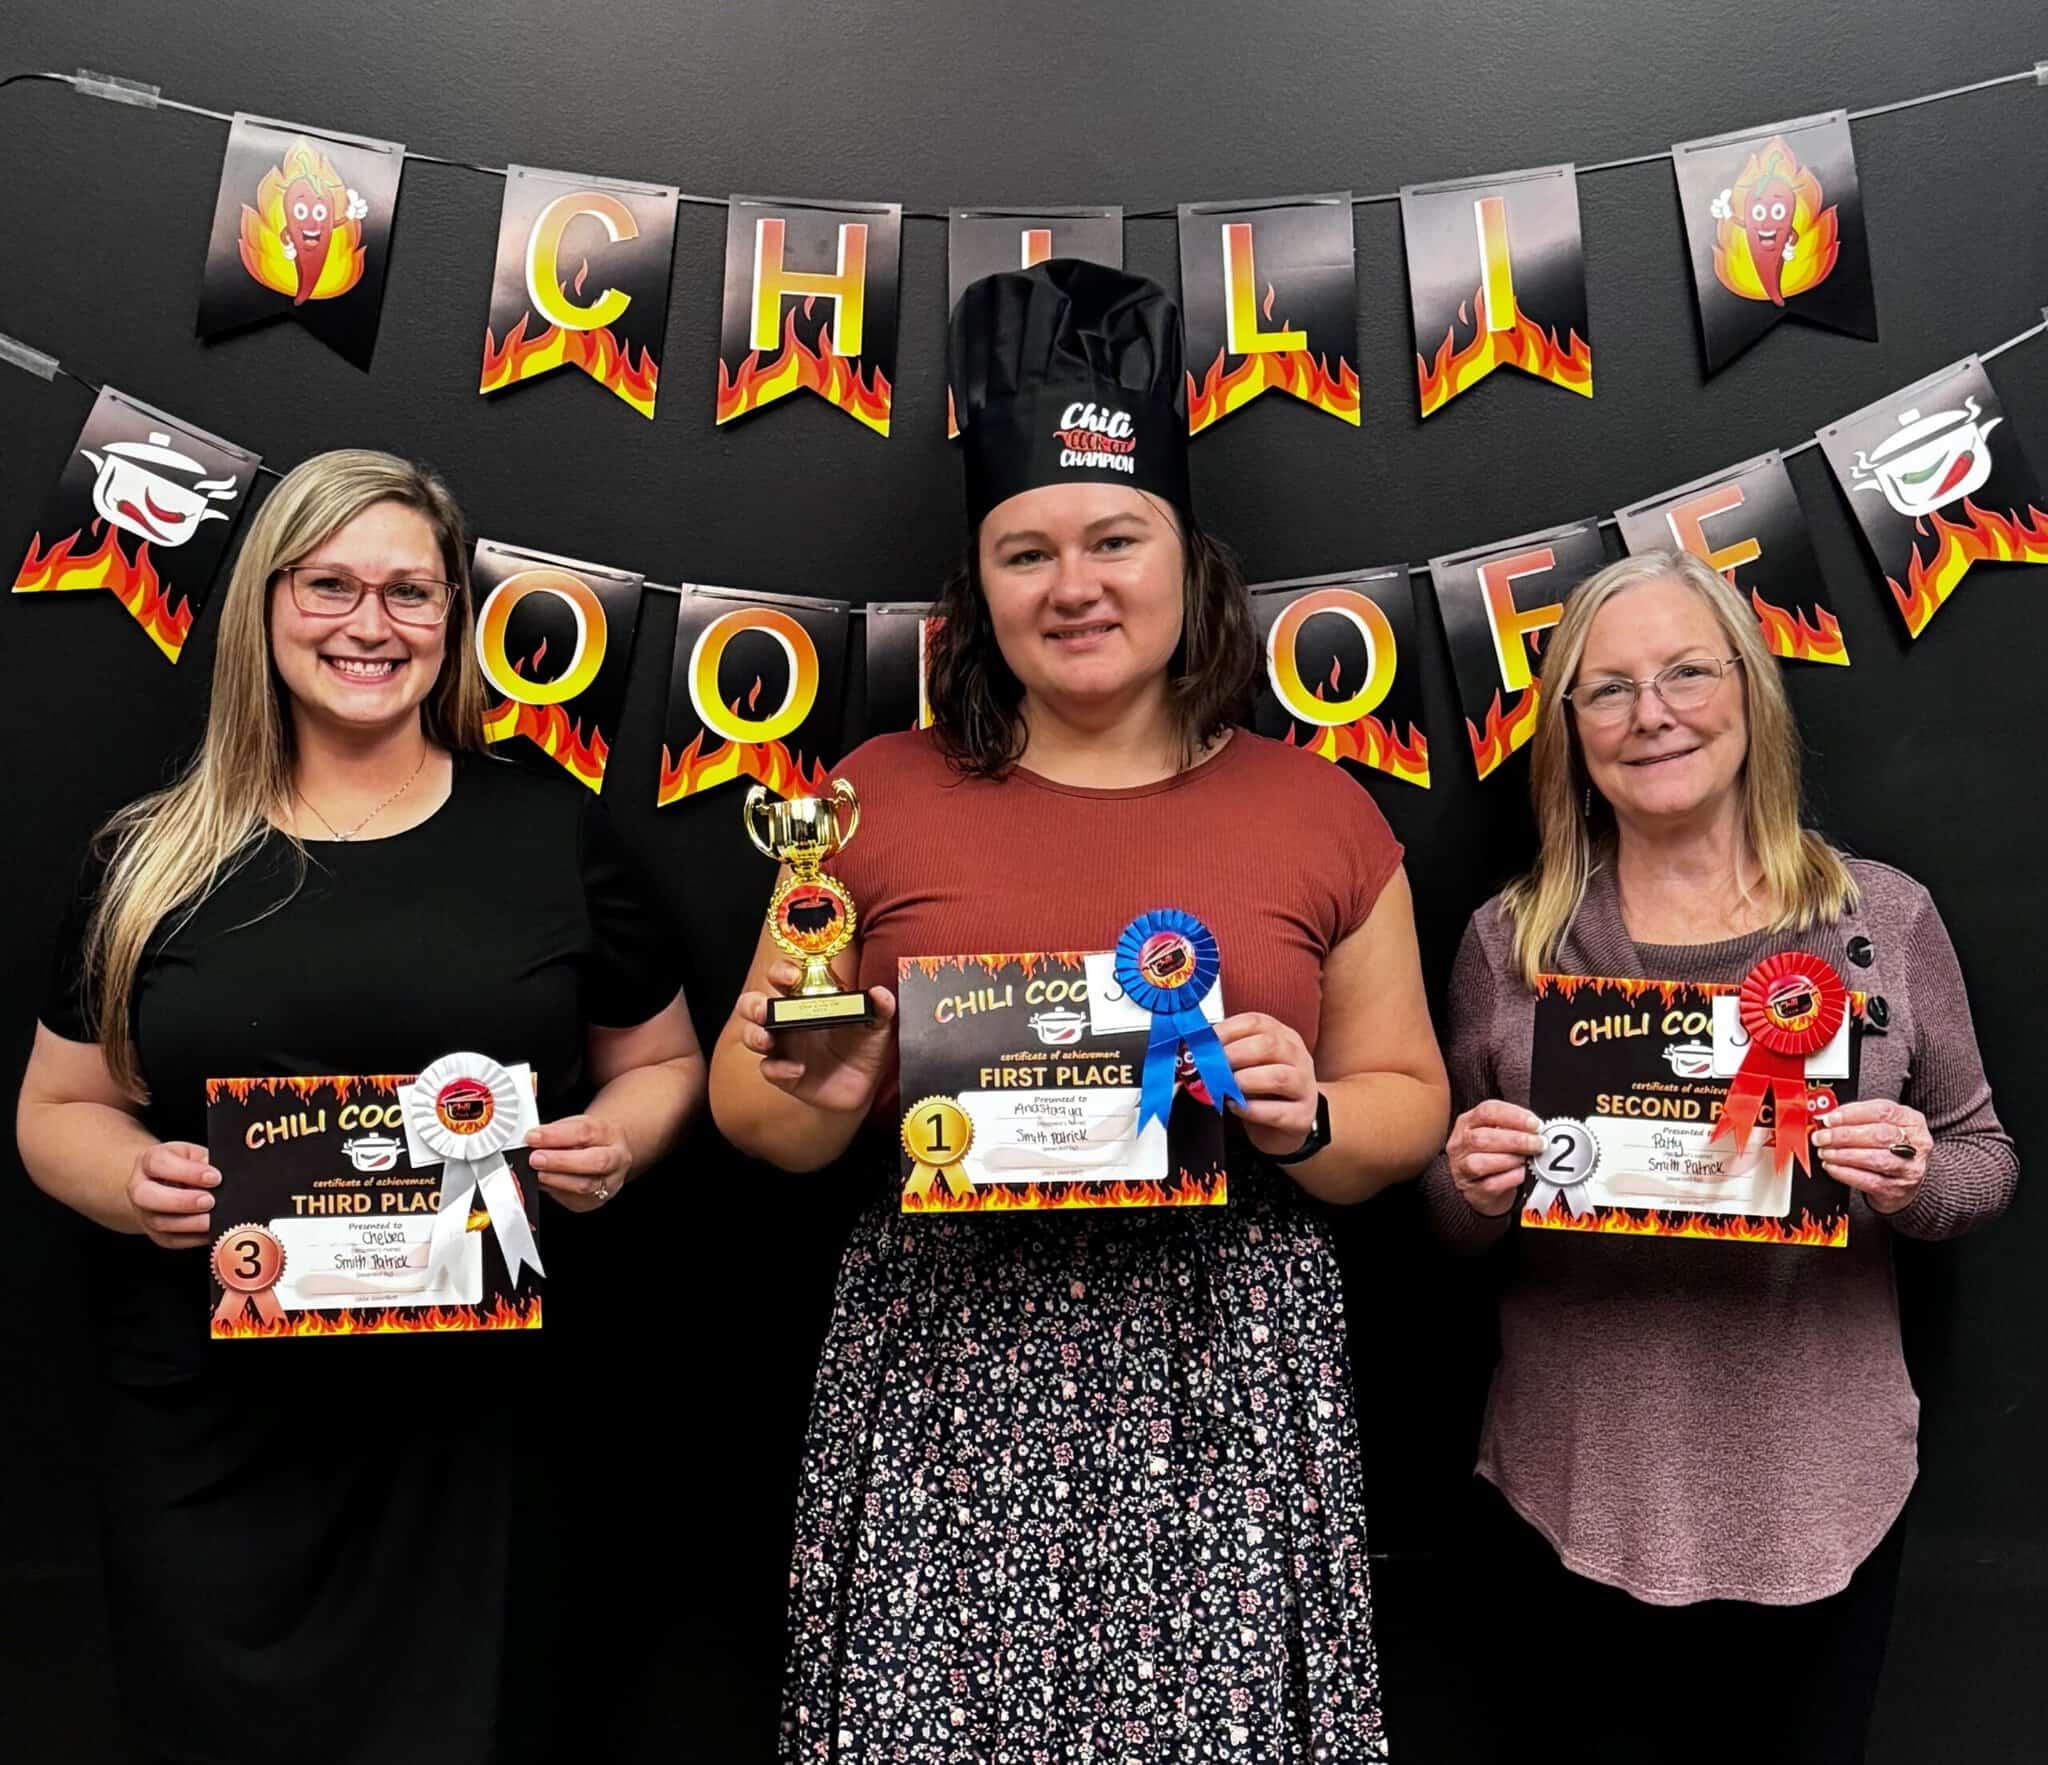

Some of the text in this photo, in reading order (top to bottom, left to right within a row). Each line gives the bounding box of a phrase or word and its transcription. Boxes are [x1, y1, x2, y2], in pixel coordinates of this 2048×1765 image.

[526, 191, 1516, 357] CHLI
[1060, 402, 1134, 438] Chili
[1060, 449, 1135, 474] CHAMPION
[1266, 484, 1762, 727] OFF
[934, 984, 1013, 1024] CHILI
[1025, 979, 1088, 1005] COO
[1569, 1012, 1650, 1047] CHILI
[1661, 1010, 1713, 1036] CO
[1000, 1049, 1121, 1062] certificate of achievement
[980, 1064, 1134, 1088] FIRST PLACE
[1632, 1081, 1679, 1093] certificate
[1681, 1082, 1692, 1094] of
[1034, 1096, 1076, 1104] Presented
[1595, 1093, 1700, 1119] SECOND
[245, 1104, 404, 1149] CHILI COO
[926, 1113, 952, 1152] 1
[1016, 1128, 1048, 1145] Smith
[1663, 1127, 1705, 1137] Presented
[1548, 1134, 1575, 1172] 2
[1651, 1133, 1684, 1157] Patty
[313, 1176, 436, 1188] certificate of achievement
[291, 1191, 442, 1215] THIRD PLAC
[348, 1222, 403, 1231] Presented to
[234, 1240, 262, 1279] 3
